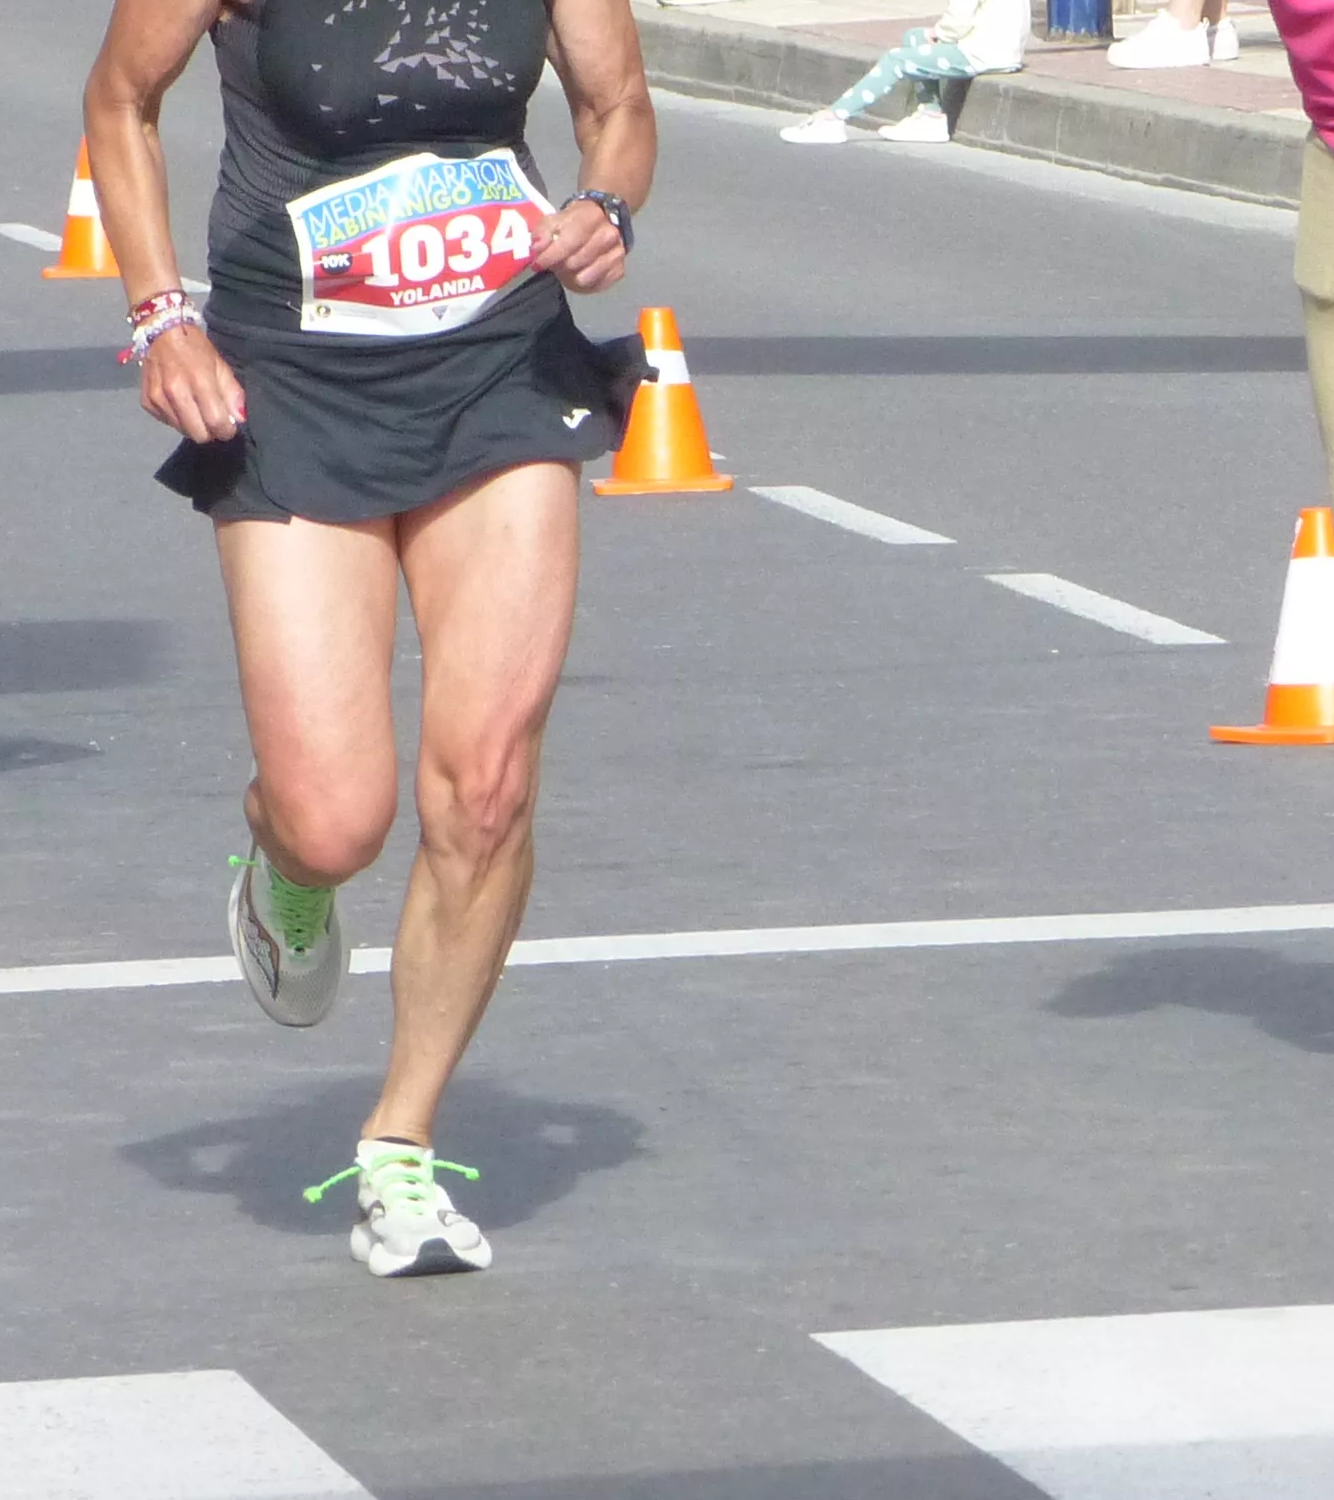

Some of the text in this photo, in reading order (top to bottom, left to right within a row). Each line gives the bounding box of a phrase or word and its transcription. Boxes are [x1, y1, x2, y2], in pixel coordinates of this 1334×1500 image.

[307, 160, 517, 237] MEDIA MARATON
[478, 182, 524, 202] 2024
[320, 207, 532, 288] 10K 1034
[389, 276, 486, 307] YOLANDA
